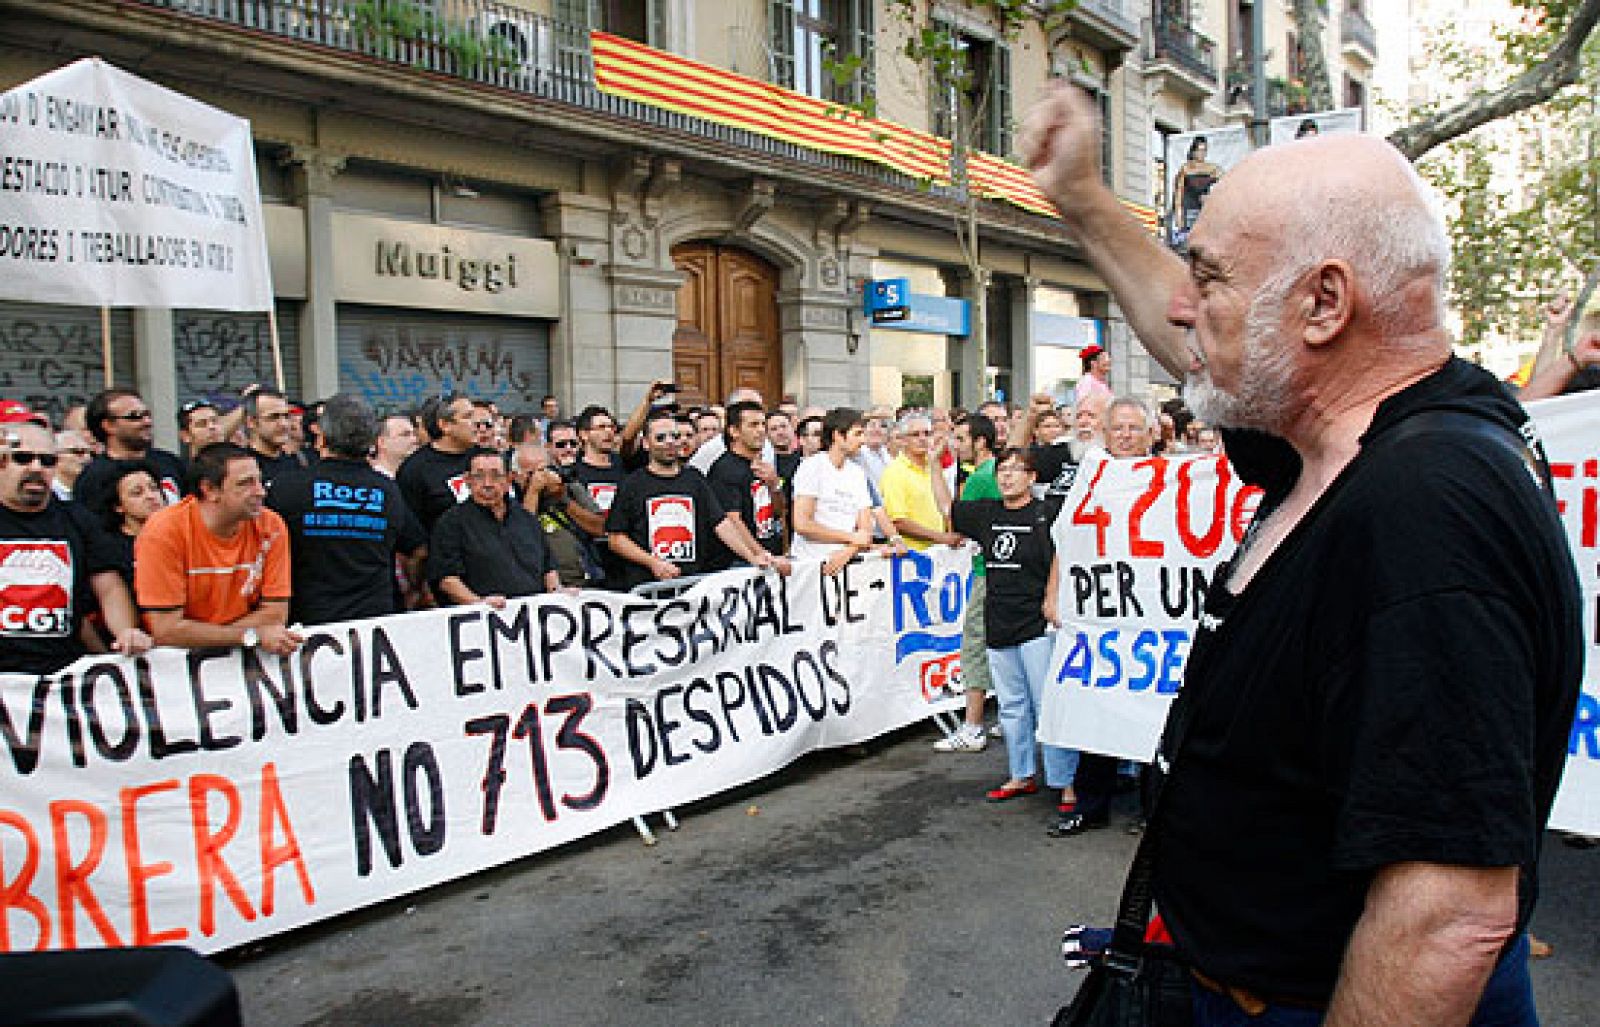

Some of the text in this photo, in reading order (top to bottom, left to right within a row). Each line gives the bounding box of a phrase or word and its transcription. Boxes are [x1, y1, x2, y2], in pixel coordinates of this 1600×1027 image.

[375, 240, 517, 294] Muiggi
[313, 480, 384, 504] Roca
[1069, 560, 1146, 618] PER
[2, 604, 68, 633] CGT
[0, 627, 420, 775] VIOLENCIA
[447, 571, 804, 698] EMPRESARIAL
[1058, 629, 1192, 693] ASSE
[0, 640, 851, 953] BRERA NO 713 DESPIDOS
